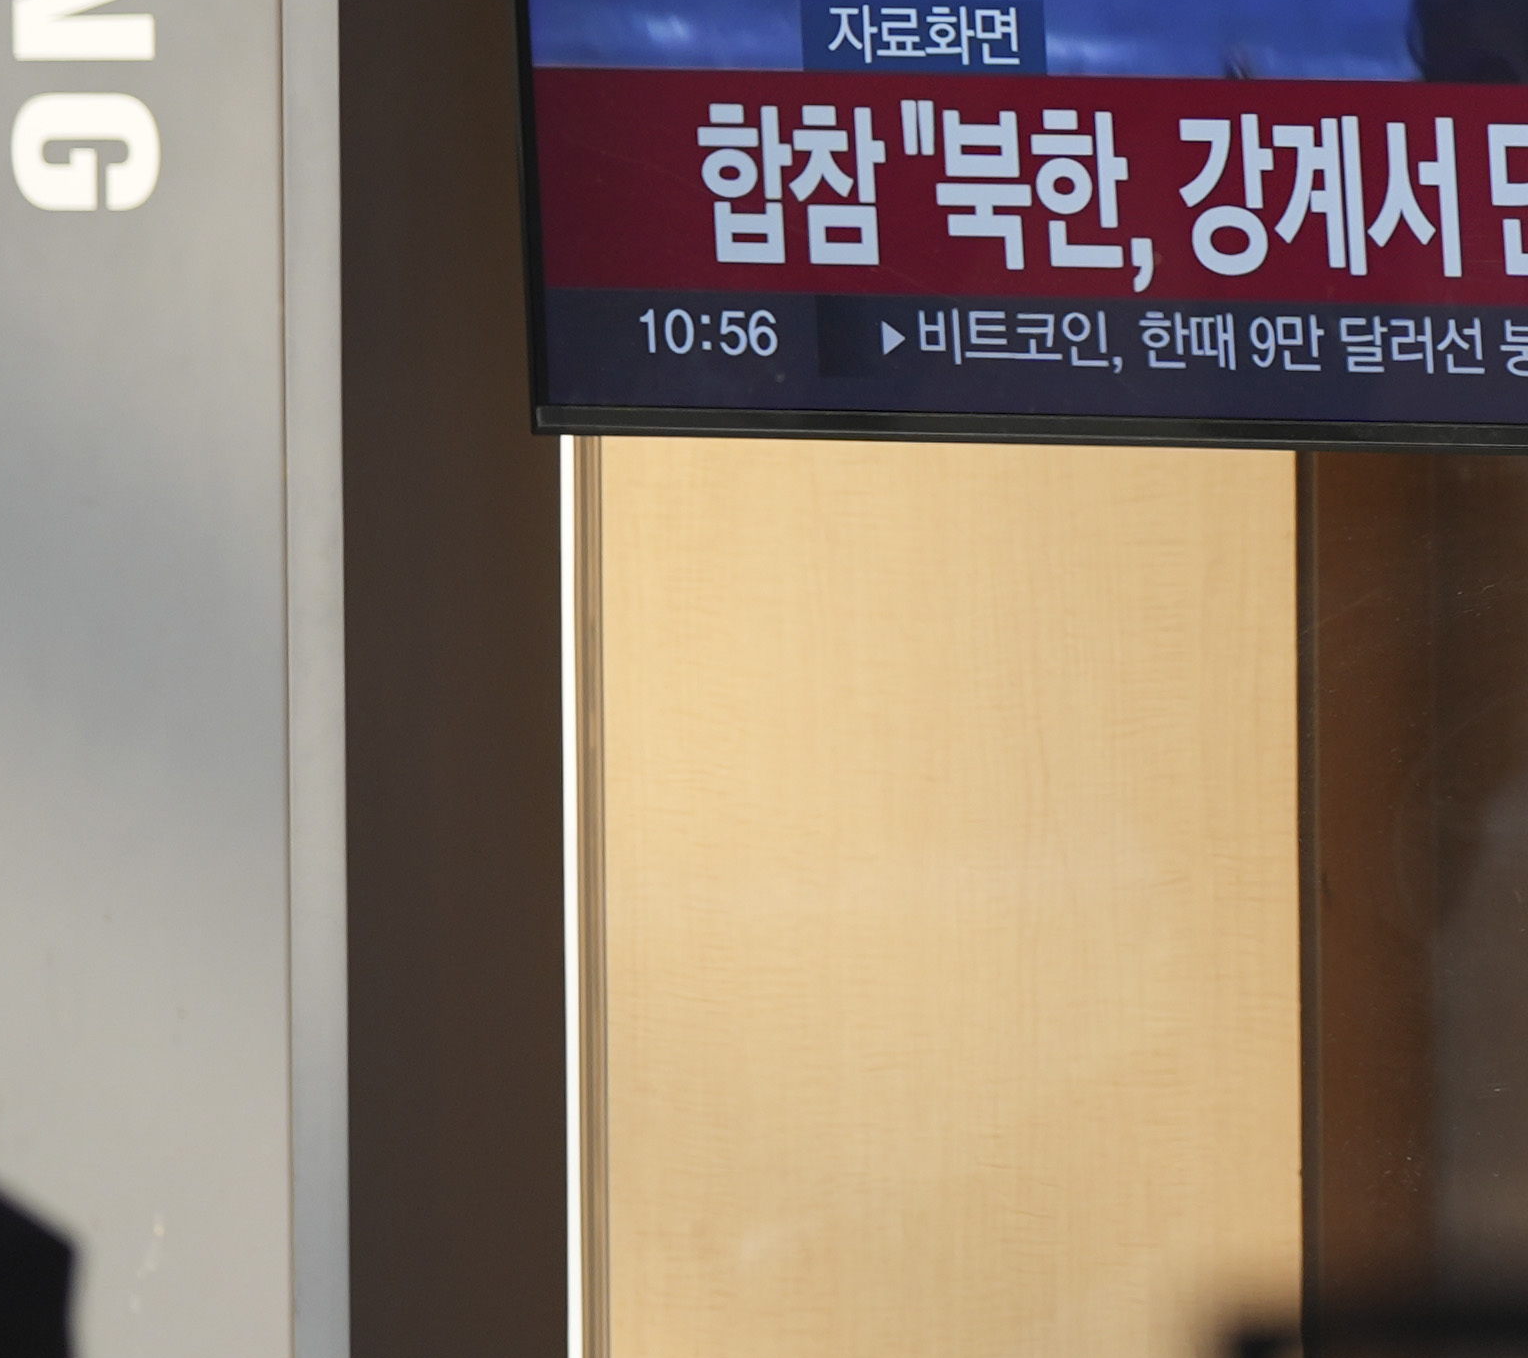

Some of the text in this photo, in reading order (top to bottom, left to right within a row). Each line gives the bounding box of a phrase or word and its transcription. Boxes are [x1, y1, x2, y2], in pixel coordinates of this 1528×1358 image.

[828, 4, 1020, 66] 자료화면
[1179, 113, 1463, 278] 강계서
[639, 308, 779, 357] 10:56
[918, 308, 1123, 374] 비트코인,
[1138, 311, 1237, 371] 한때
[1249, 314, 1325, 372] 9만
[1340, 315, 1486, 375] 달러선
